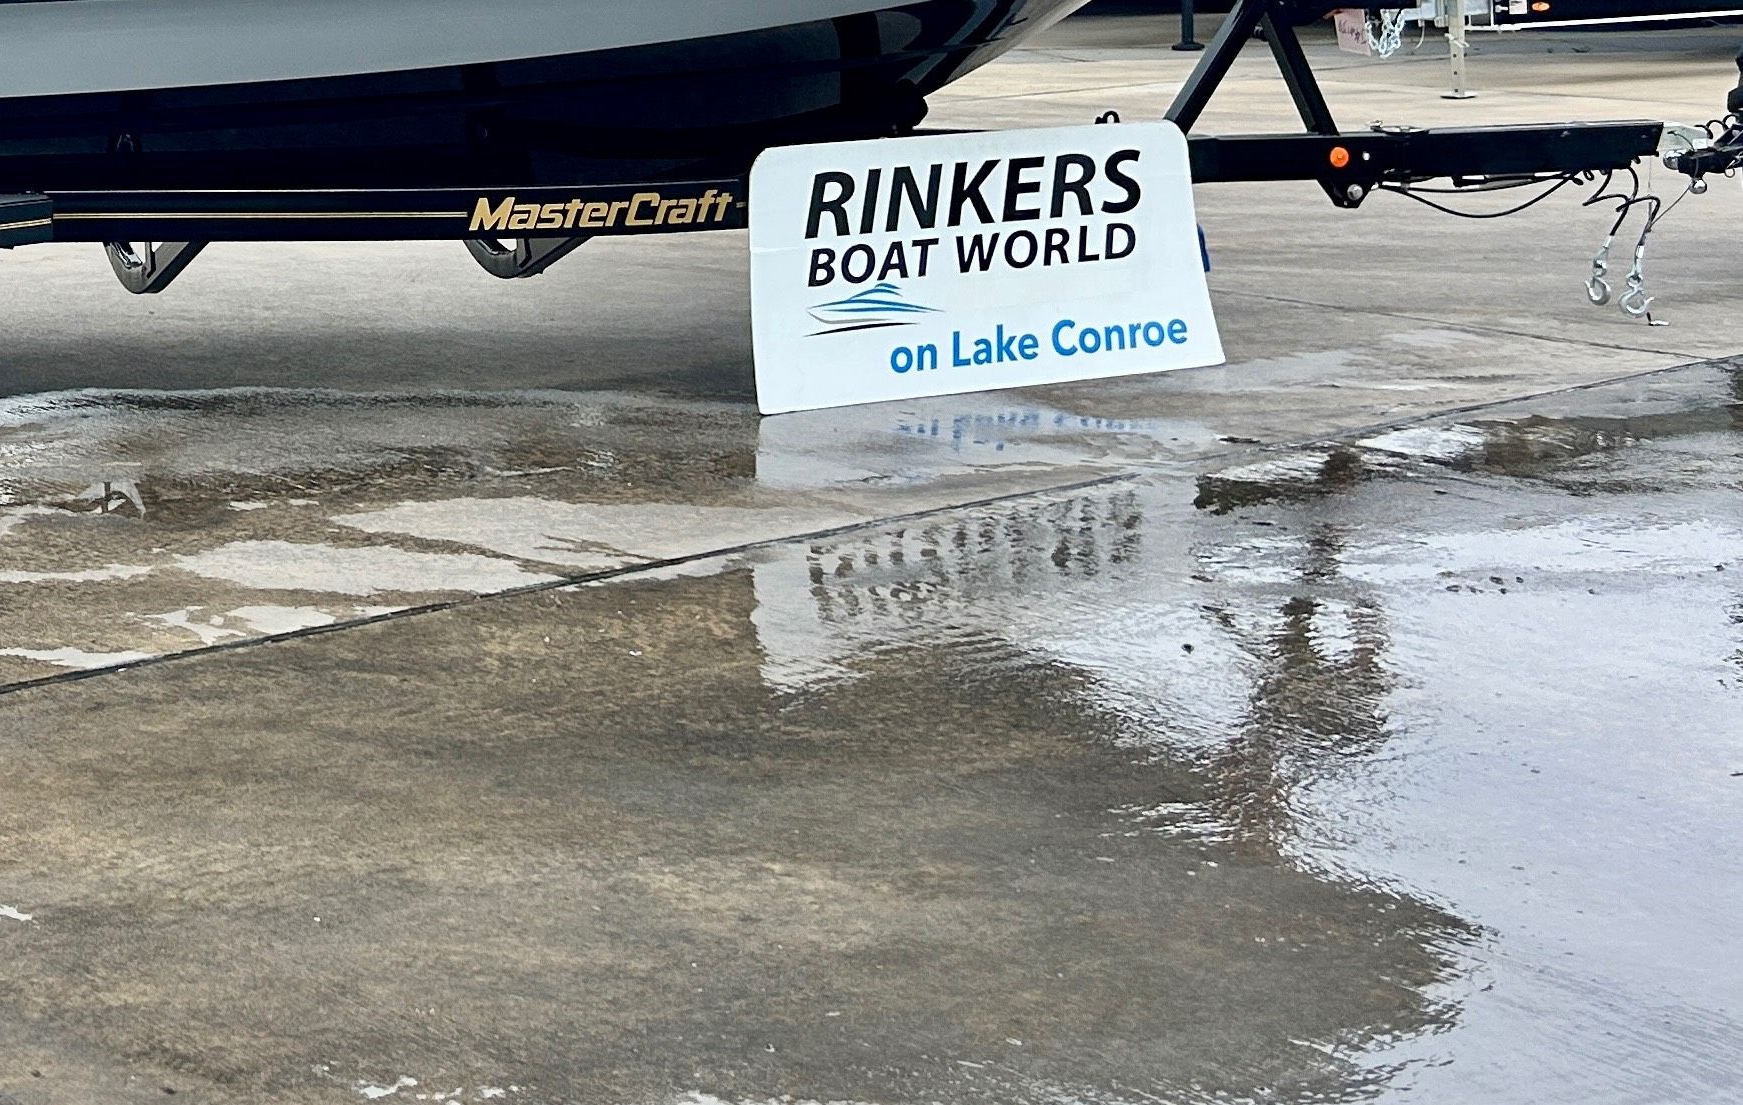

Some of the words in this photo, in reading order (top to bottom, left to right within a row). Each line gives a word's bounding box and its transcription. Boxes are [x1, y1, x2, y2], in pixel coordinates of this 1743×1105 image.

[468, 189, 733, 231] MasterCraft
[804, 149, 1141, 239] RINKERS
[807, 237, 939, 287] BOAT
[955, 222, 1137, 274] WORLD
[890, 342, 938, 374] on
[952, 324, 1039, 368] Lake
[1051, 317, 1188, 356] Conroe
